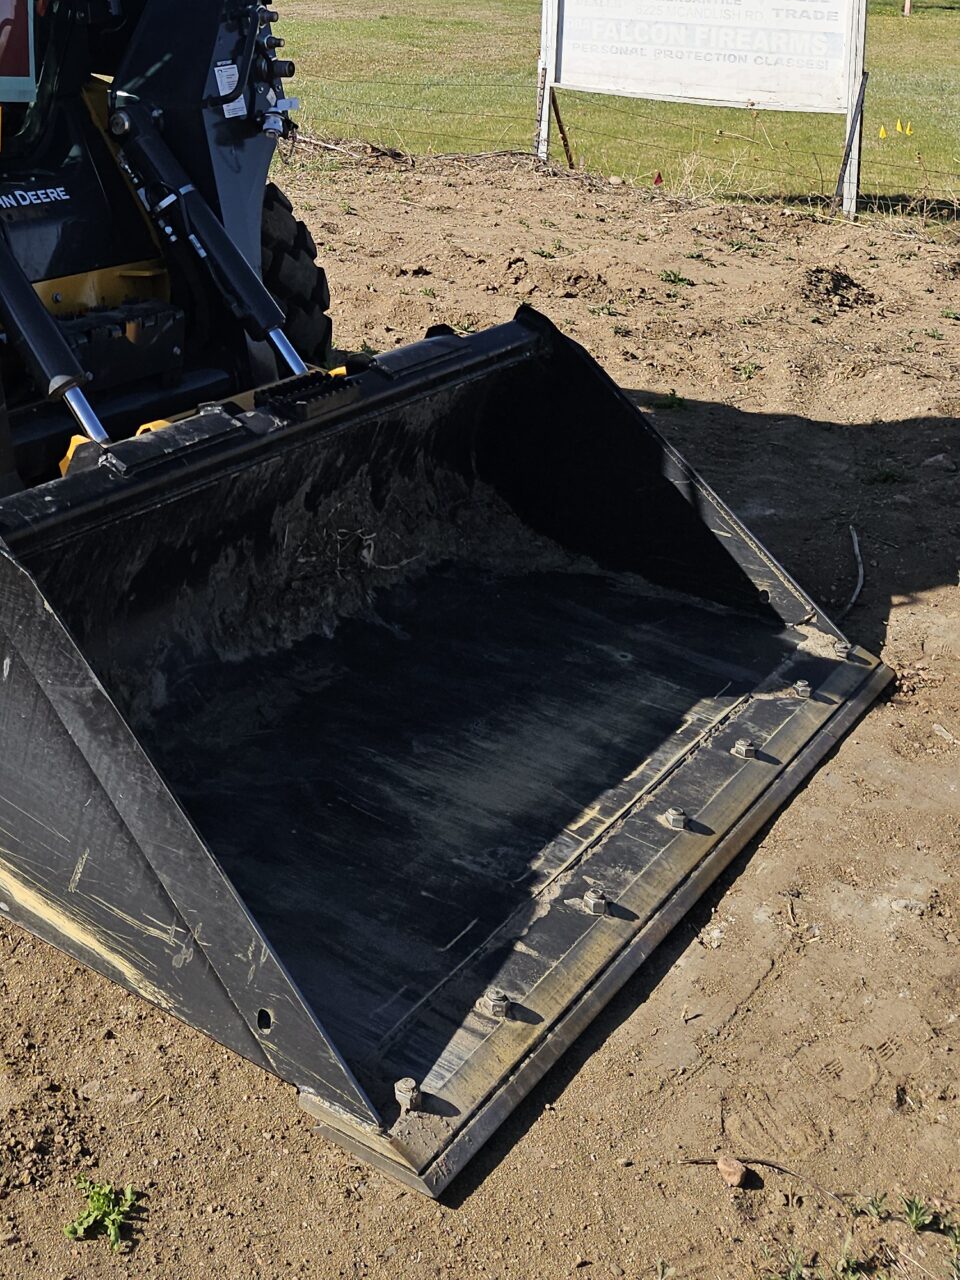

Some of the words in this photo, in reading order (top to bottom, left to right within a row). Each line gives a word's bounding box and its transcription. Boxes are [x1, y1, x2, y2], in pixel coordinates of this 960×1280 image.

[772, 7, 840, 22] TRADE
[592, 20, 688, 45] FALCON
[695, 27, 829, 56] FIREARMS
[572, 42, 648, 57] PERSONAL
[653, 48, 748, 64] PROTECTION
[14, 187, 70, 206] DEERE
